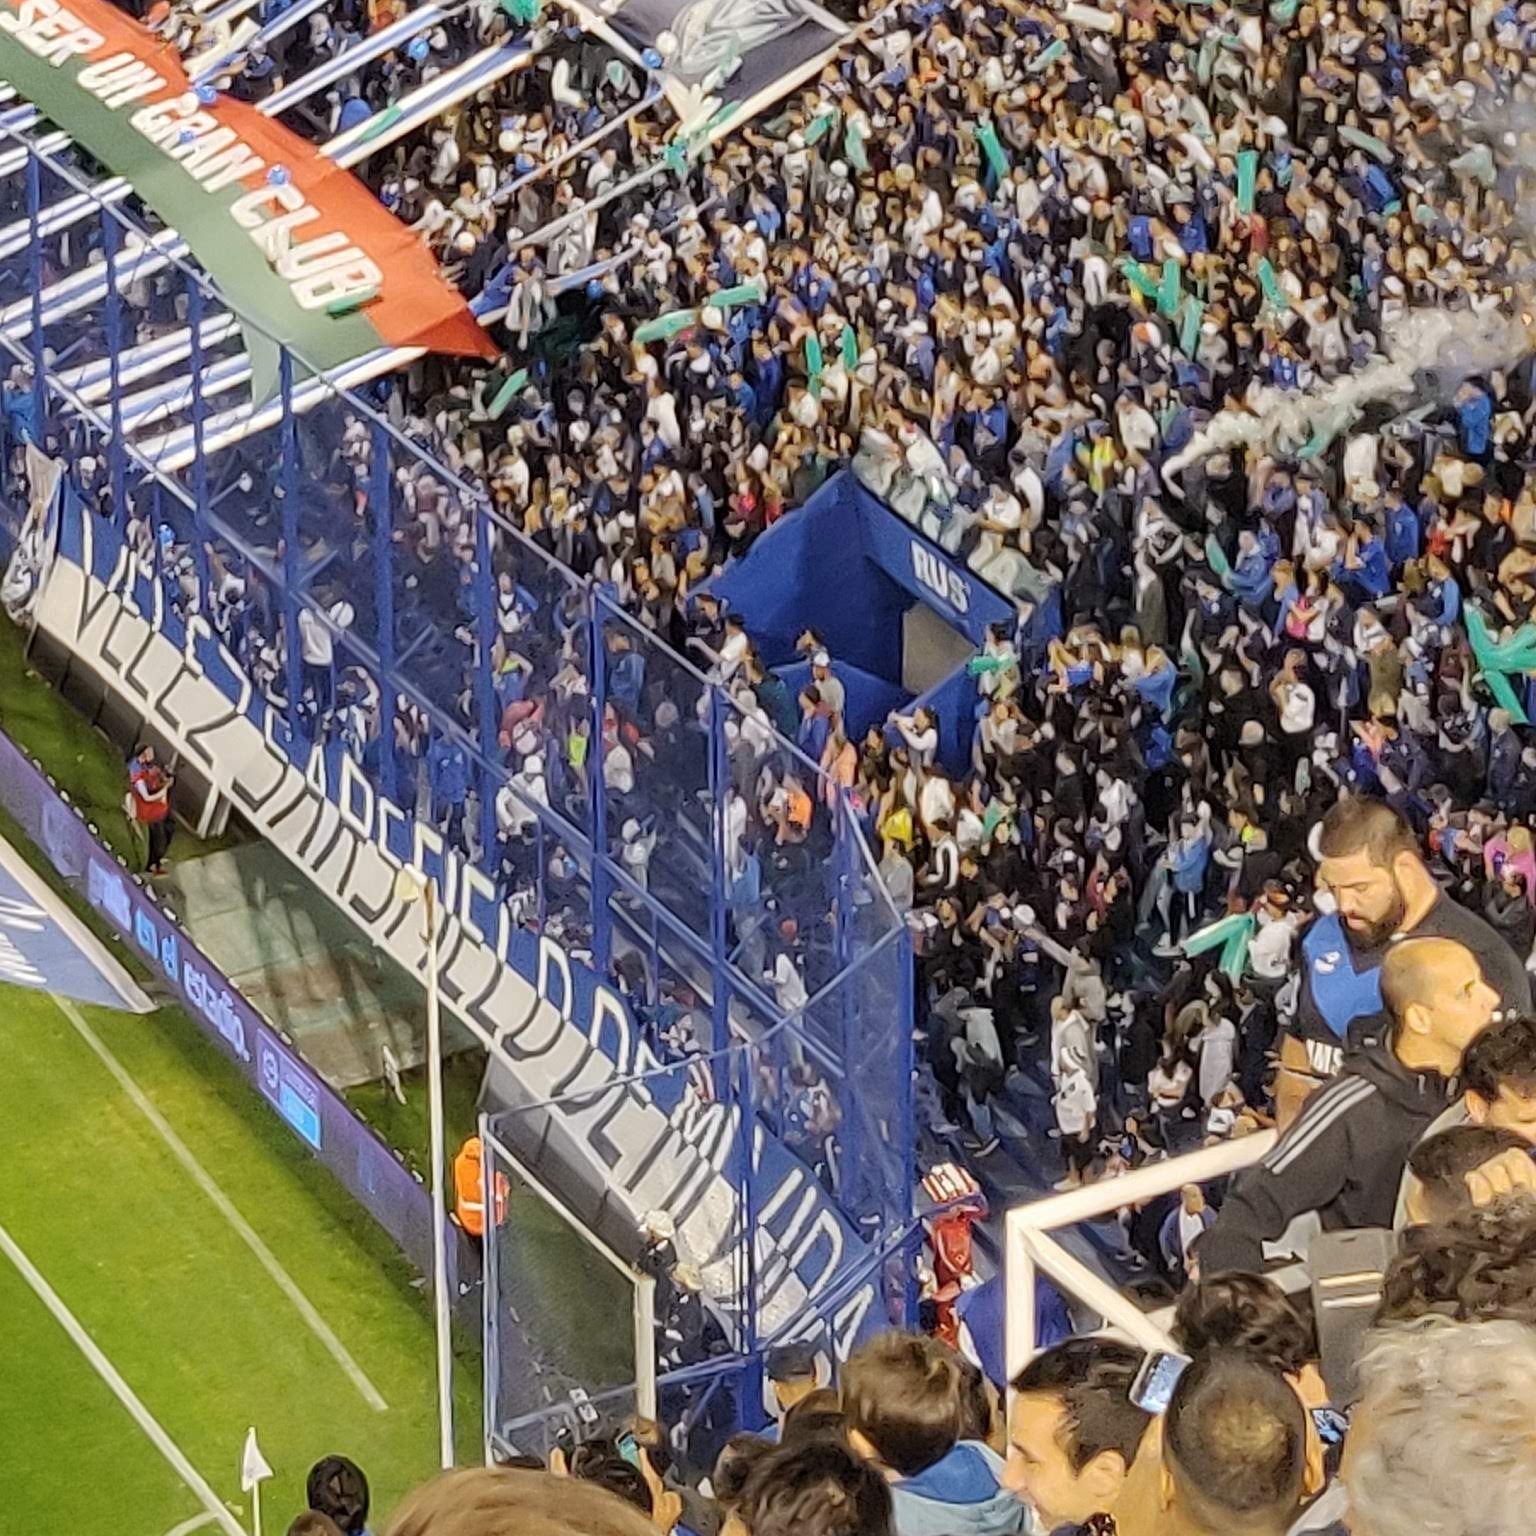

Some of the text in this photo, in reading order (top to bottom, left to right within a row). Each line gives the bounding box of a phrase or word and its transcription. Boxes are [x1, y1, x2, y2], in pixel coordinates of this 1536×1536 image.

[75, 52, 168, 110] UN
[128, 94, 265, 194] GRAN
[229, 184, 384, 311] CLUB
[910, 538, 969, 615] RUS
